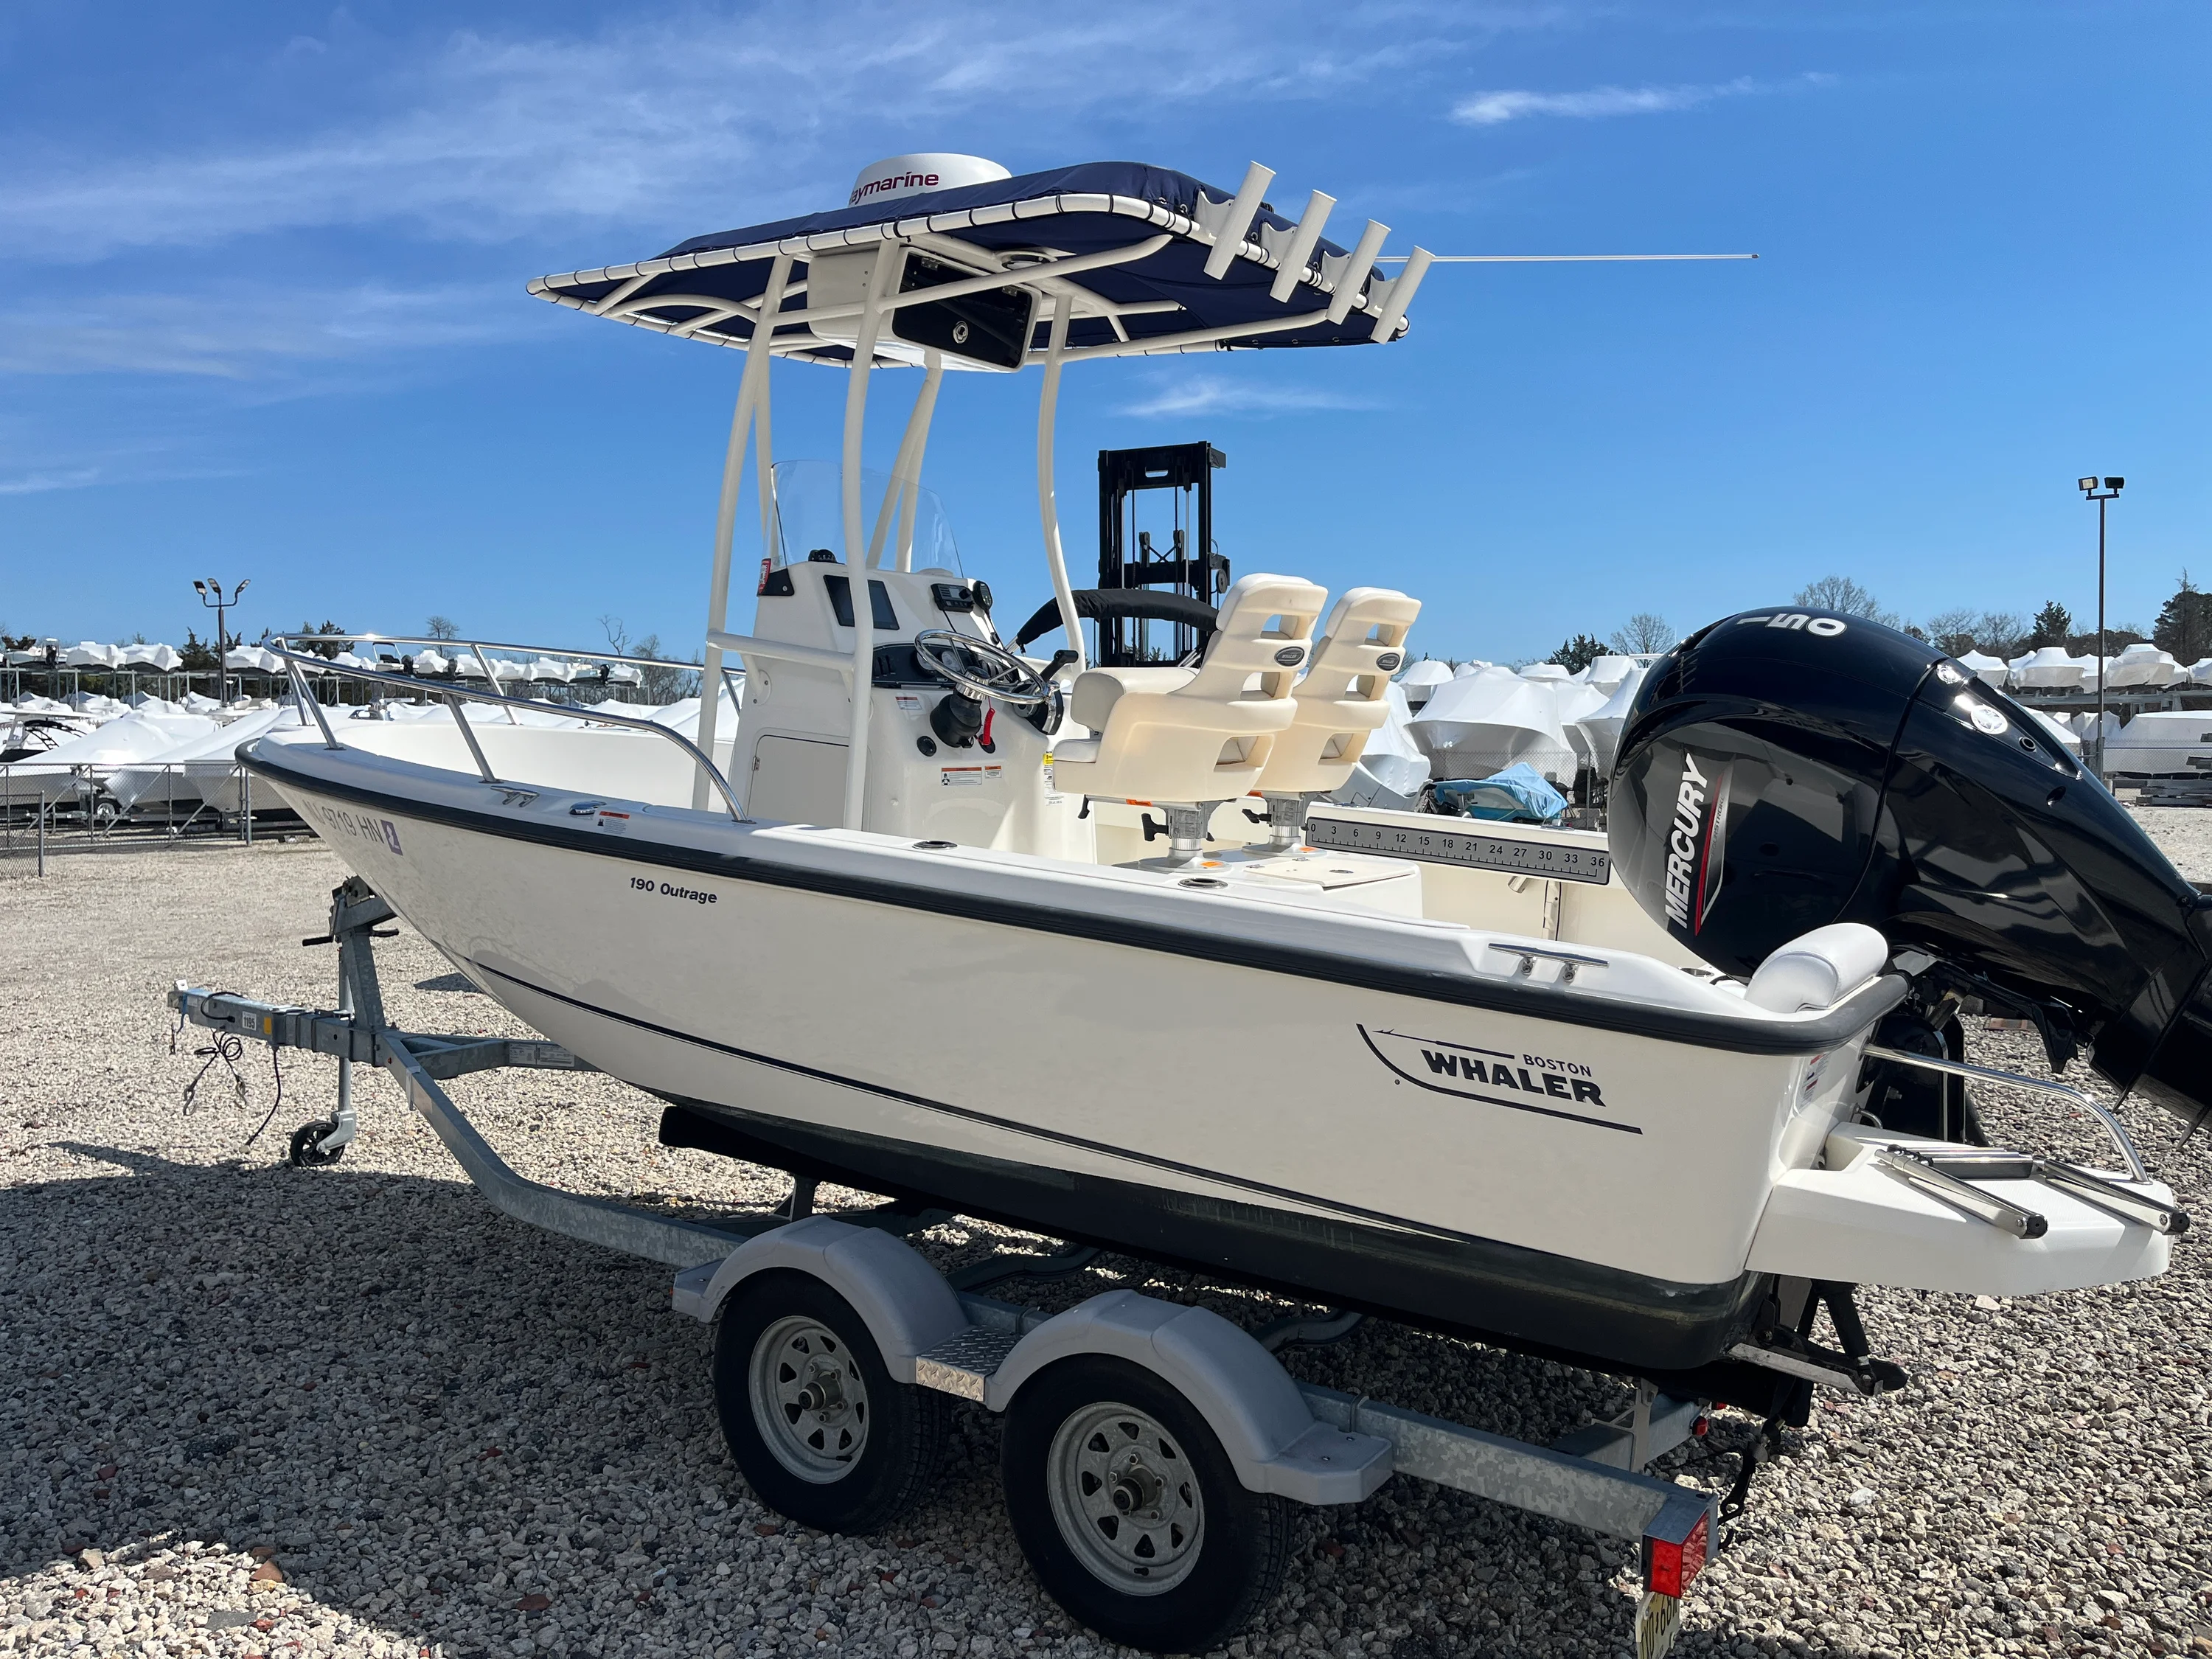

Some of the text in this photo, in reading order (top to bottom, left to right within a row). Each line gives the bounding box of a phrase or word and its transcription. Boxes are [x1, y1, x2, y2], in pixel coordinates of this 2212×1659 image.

[849, 171, 939, 206] aymarine
[1736, 613, 1847, 637] 150
[322, 806, 357, 837] 9719
[355, 815, 385, 844] HN
[1665, 752, 1708, 929] MERCURY
[1310, 824, 1604, 867] 0 3 6 9 12 15 18 21 24 27 30 33 36
[630, 877, 717, 905] 190 Outrage
[1420, 1048, 1606, 1107] WHALER
[1523, 1054, 1592, 1077] BOSTON
